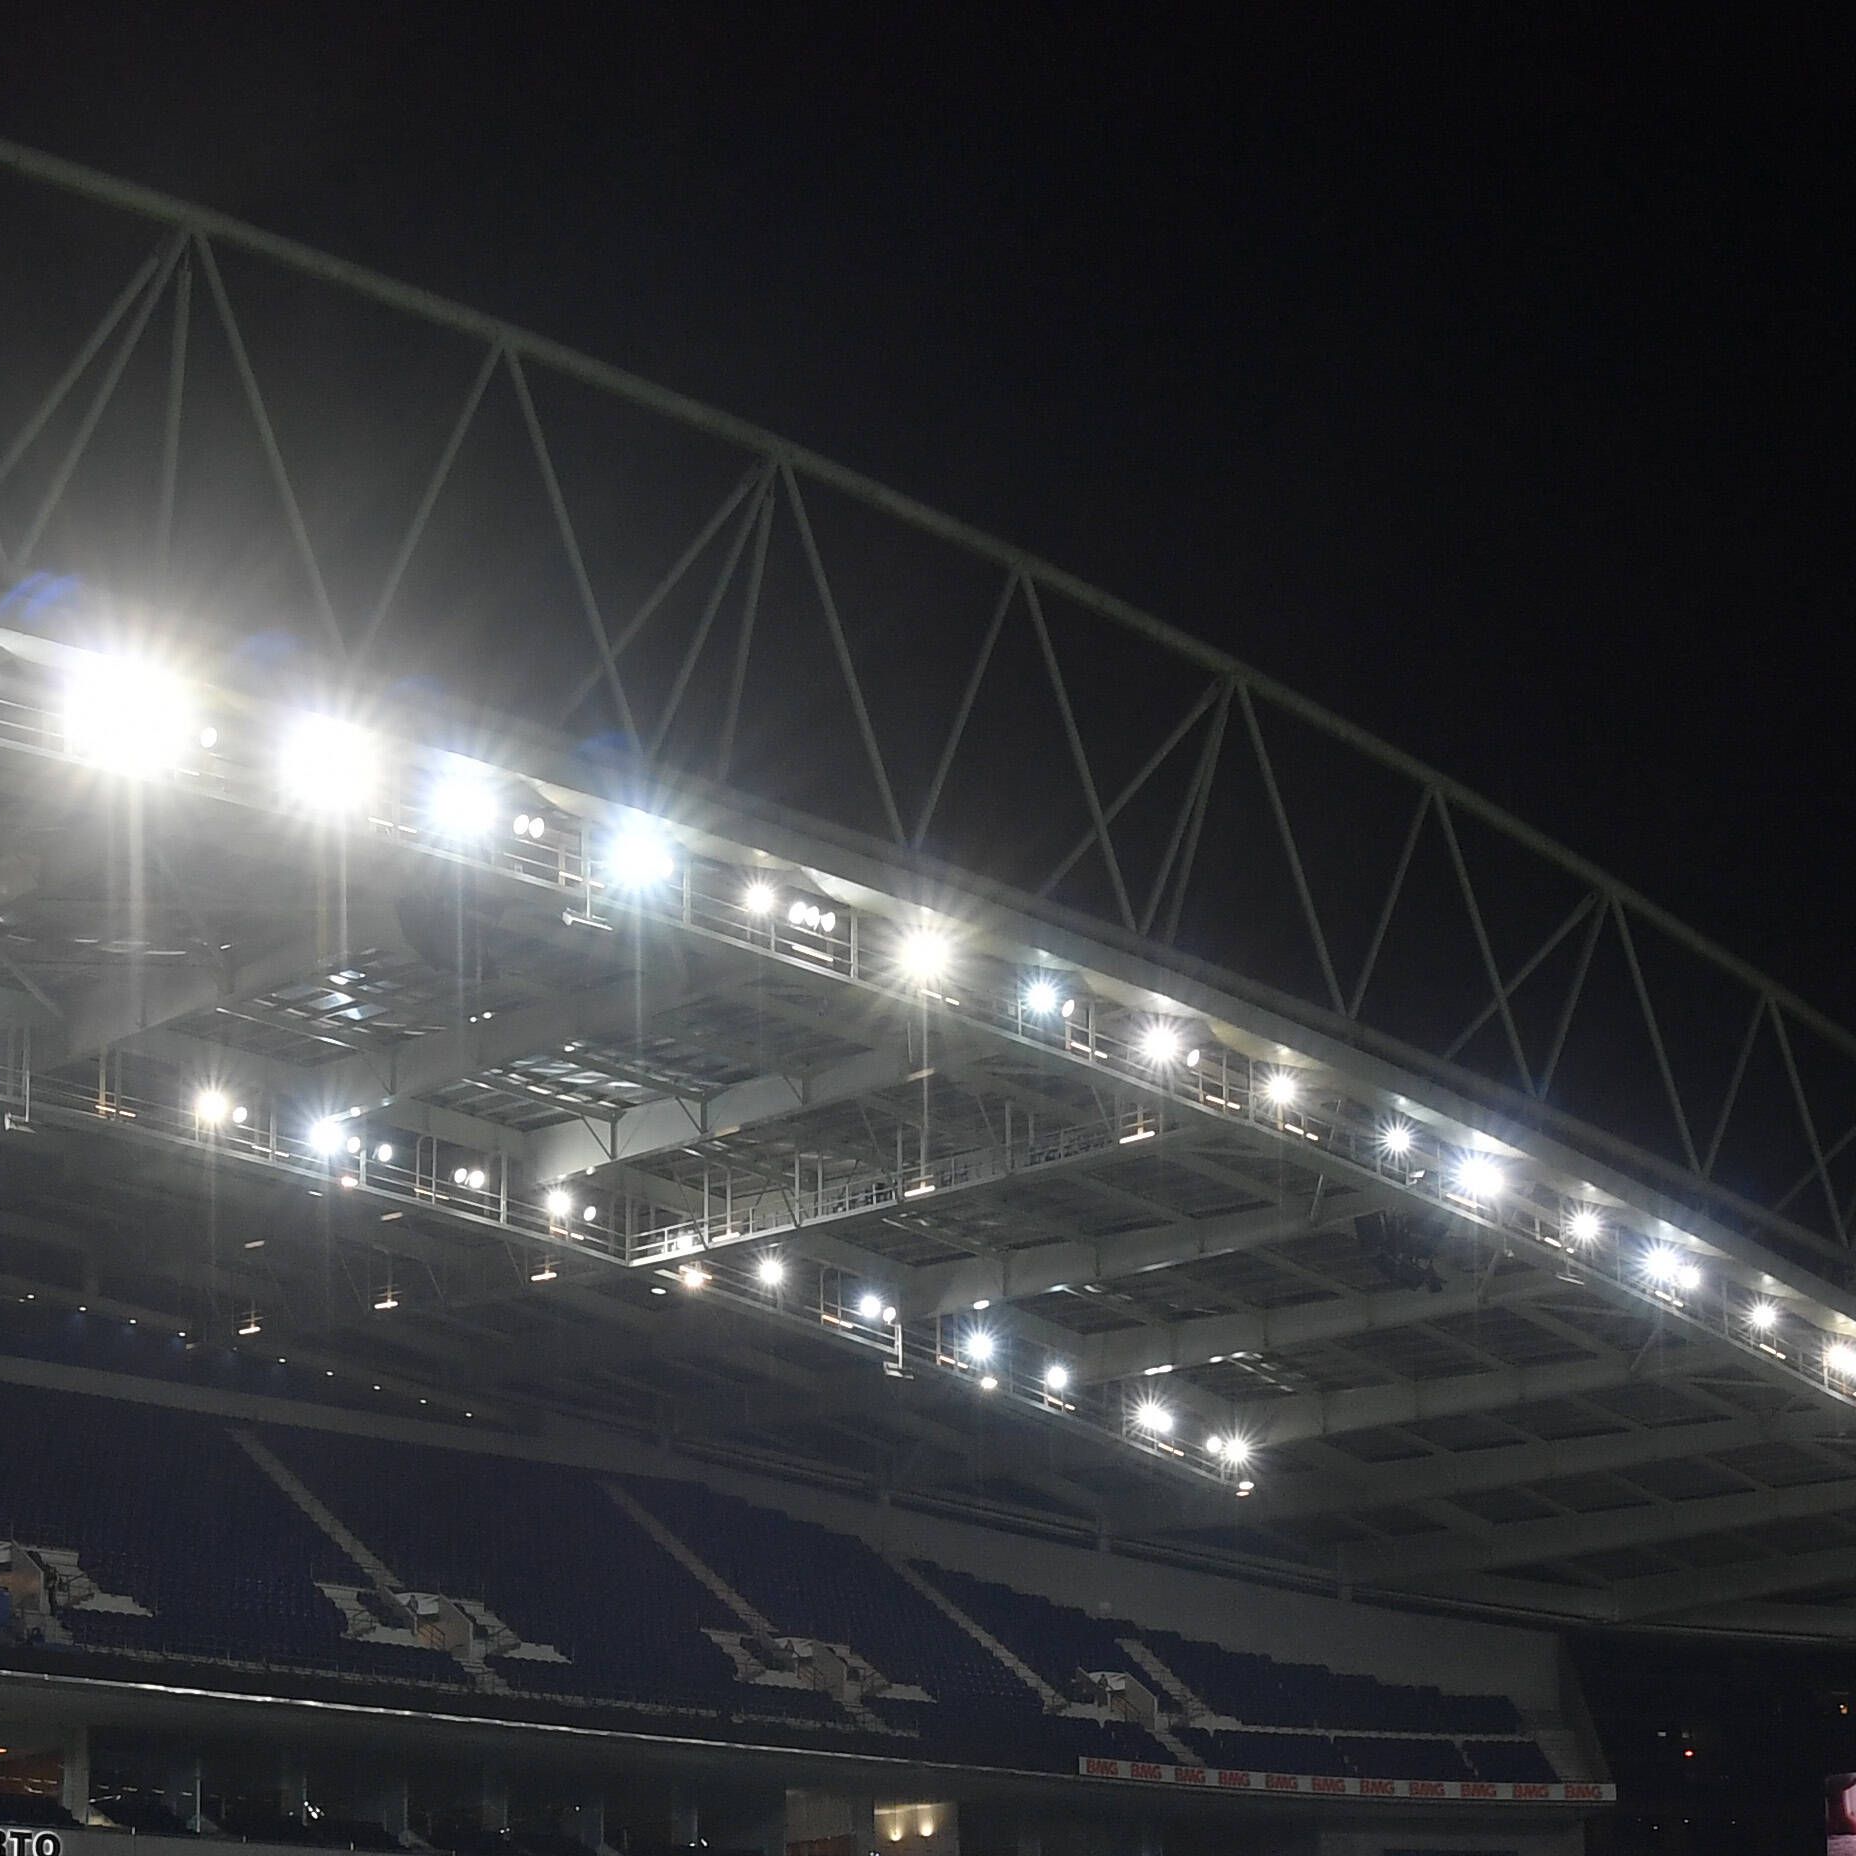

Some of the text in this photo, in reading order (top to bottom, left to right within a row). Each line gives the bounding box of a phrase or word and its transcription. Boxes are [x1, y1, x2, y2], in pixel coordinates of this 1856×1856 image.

[1086, 1758, 1603, 1799] BMG BMG BMG BMG BMG BMG BMG BMG BMG BMG BMG
